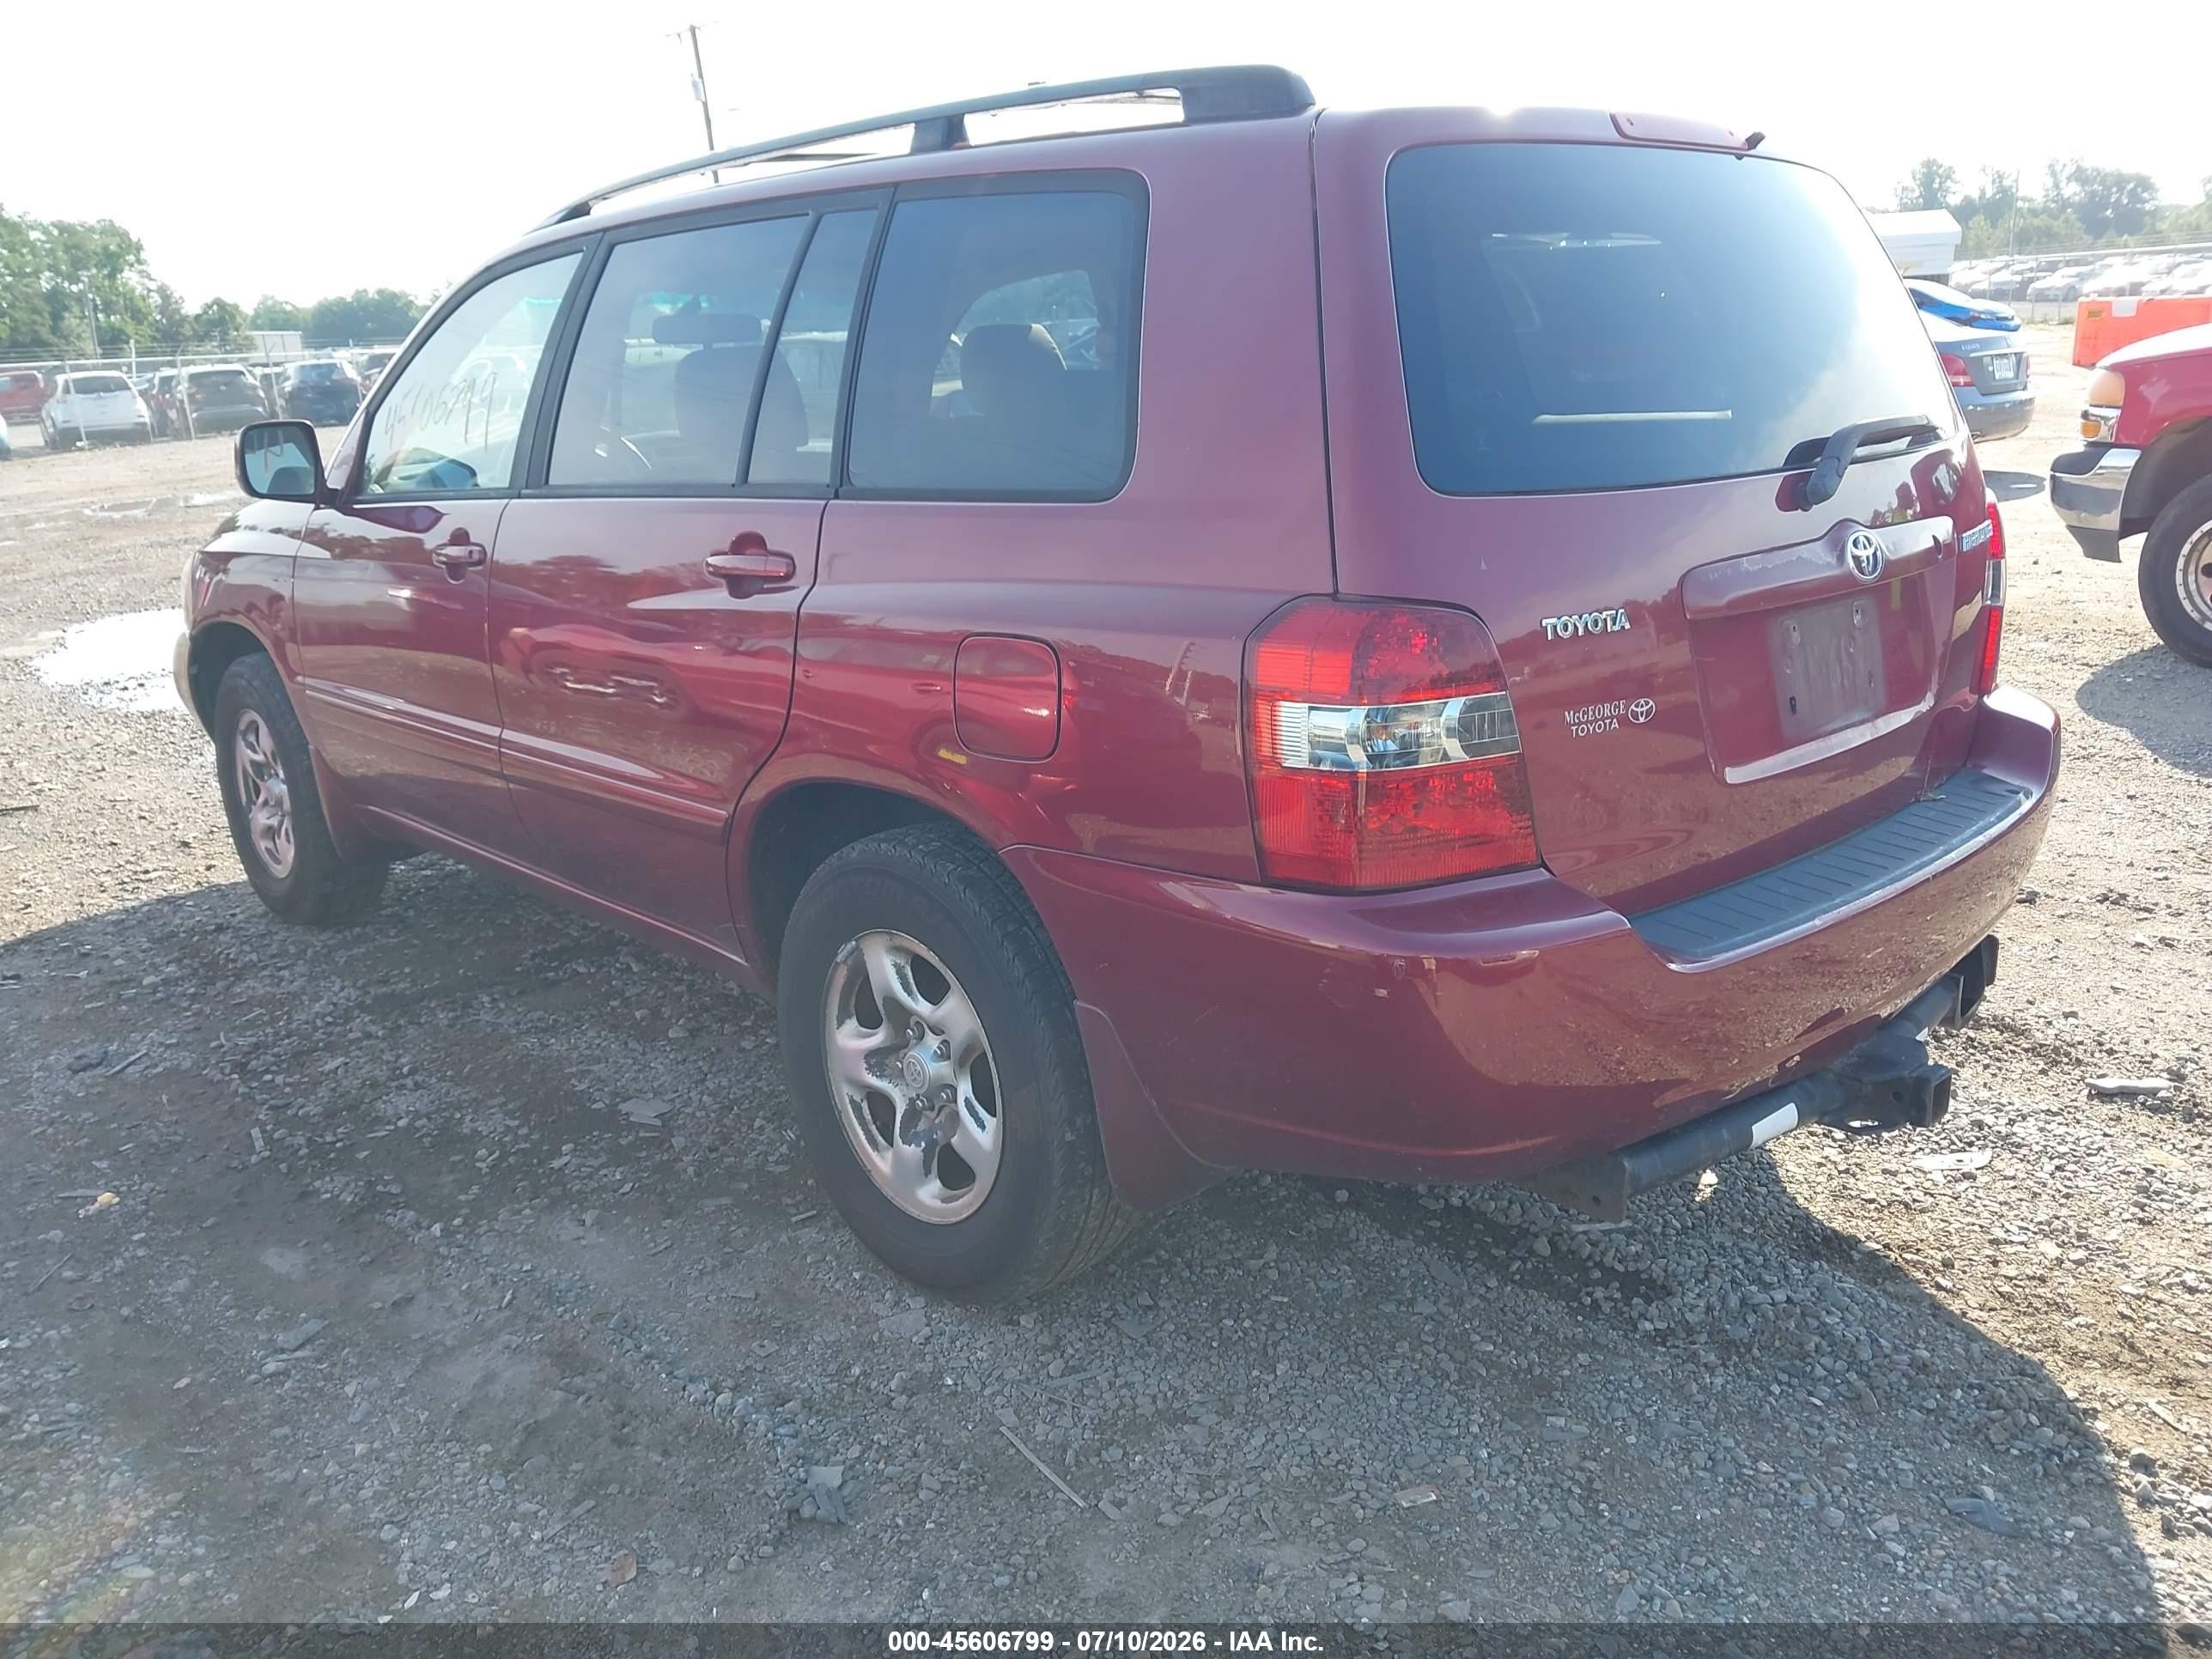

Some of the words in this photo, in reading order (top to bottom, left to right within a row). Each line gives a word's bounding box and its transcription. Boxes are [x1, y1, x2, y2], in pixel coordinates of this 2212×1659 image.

[1541, 608, 1632, 641] TOYOTA
[1564, 700, 1627, 726] McGEORGE
[1571, 718, 1620, 738] TOYOTA
